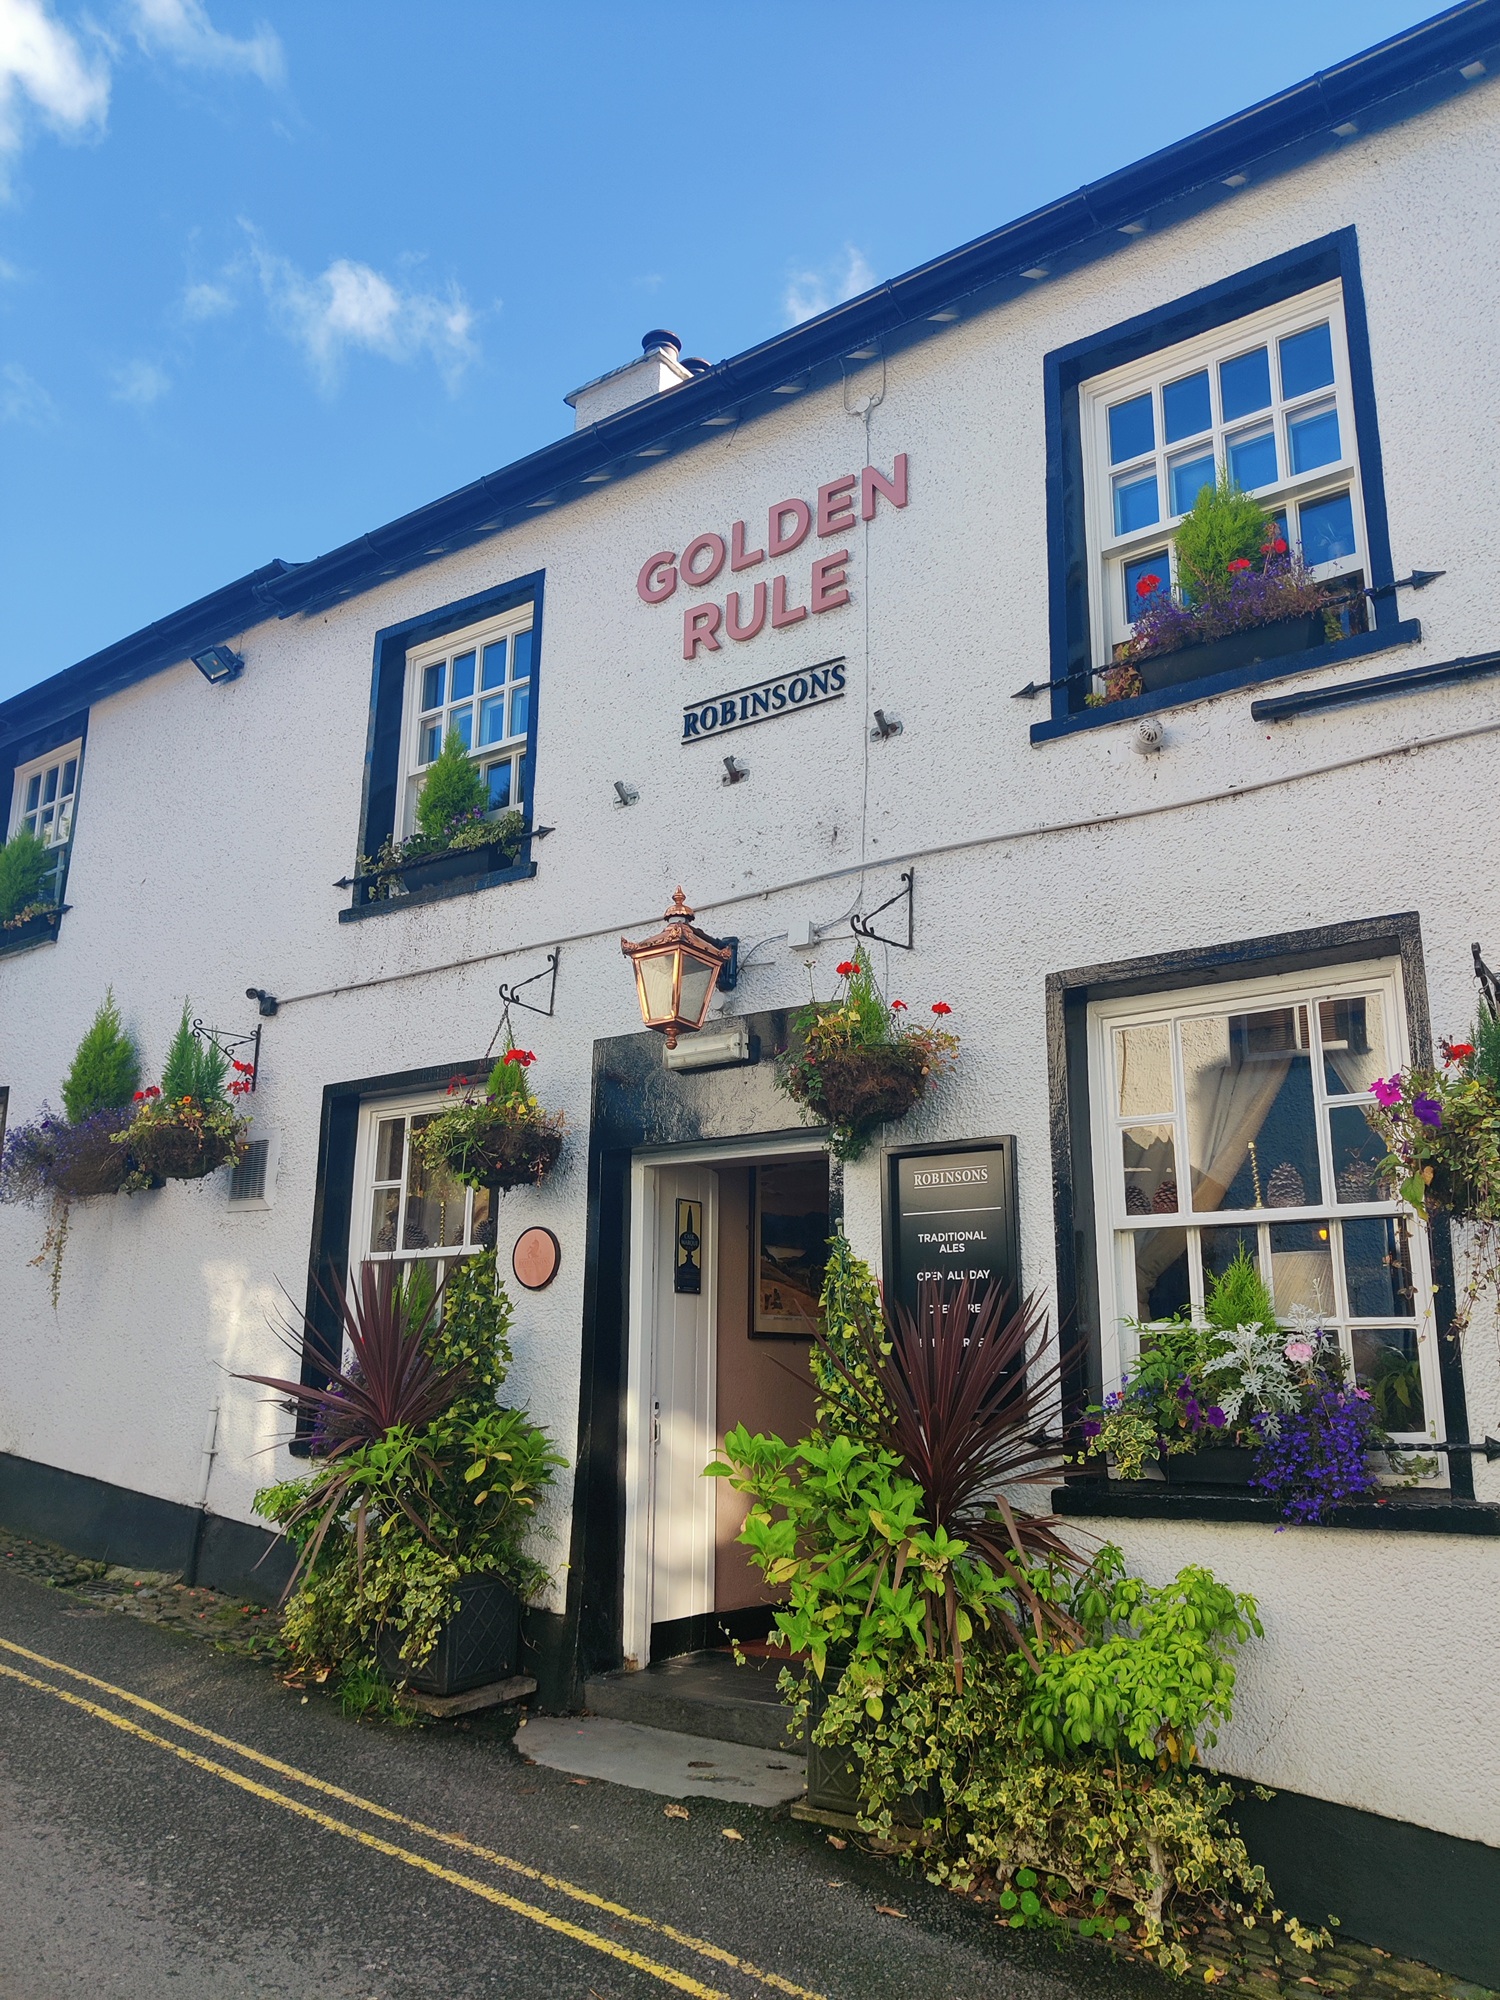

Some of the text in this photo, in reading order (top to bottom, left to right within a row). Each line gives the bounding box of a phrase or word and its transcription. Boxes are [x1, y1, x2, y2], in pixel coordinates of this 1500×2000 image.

[636, 453, 909, 604] GOLDEN
[683, 549, 850, 660] RULE
[682, 664, 846, 739] ROBINSONS
[914, 1168, 988, 1187] ROBINSONS
[918, 1231, 987, 1243] TRADITIONAL
[939, 1243, 965, 1253] ALES
[947, 1271, 965, 1280] ALL
[969, 1269, 991, 1280] DAY
